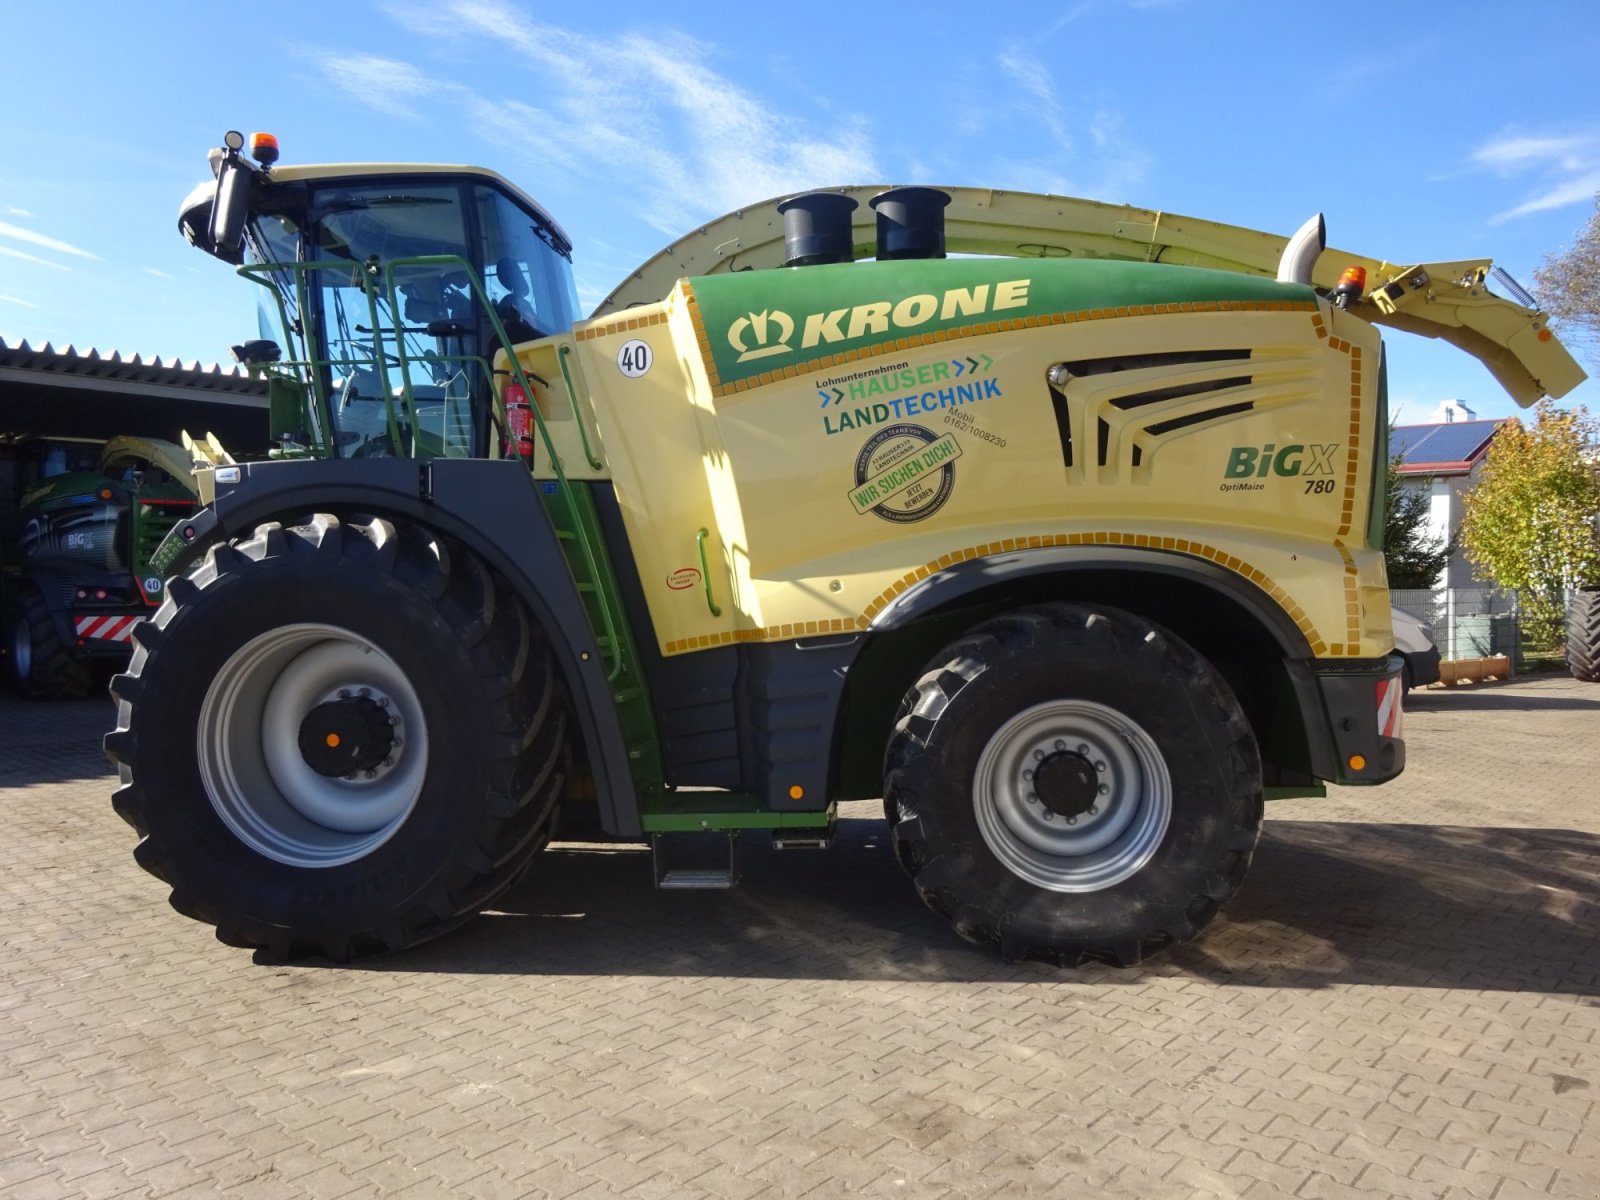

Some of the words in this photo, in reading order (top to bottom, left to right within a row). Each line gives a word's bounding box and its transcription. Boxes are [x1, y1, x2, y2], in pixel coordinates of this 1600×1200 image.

[801, 279, 1031, 349] KRONE
[622, 345, 647, 371] 40
[815, 361, 909, 389] Lohnunternehmen
[849, 361, 951, 401] HAUSER
[823, 377, 1002, 435] LANDTECHNIK
[947, 406, 976, 424] Mobil
[943, 416, 1007, 448] 0162/1008230
[875, 444, 915, 471] LANDTECHNIK
[878, 444, 901, 461] HAUSER
[854, 484, 881, 508] WIR
[878, 458, 924, 494] SUCHEN
[921, 439, 956, 468] DICH!
[1304, 479, 1335, 494] 780
[904, 487, 934, 509] BEWERBEN
[907, 483, 923, 497] JETZT
[1219, 483, 1265, 493] OptiMaize
[146, 580, 160, 591] 40
